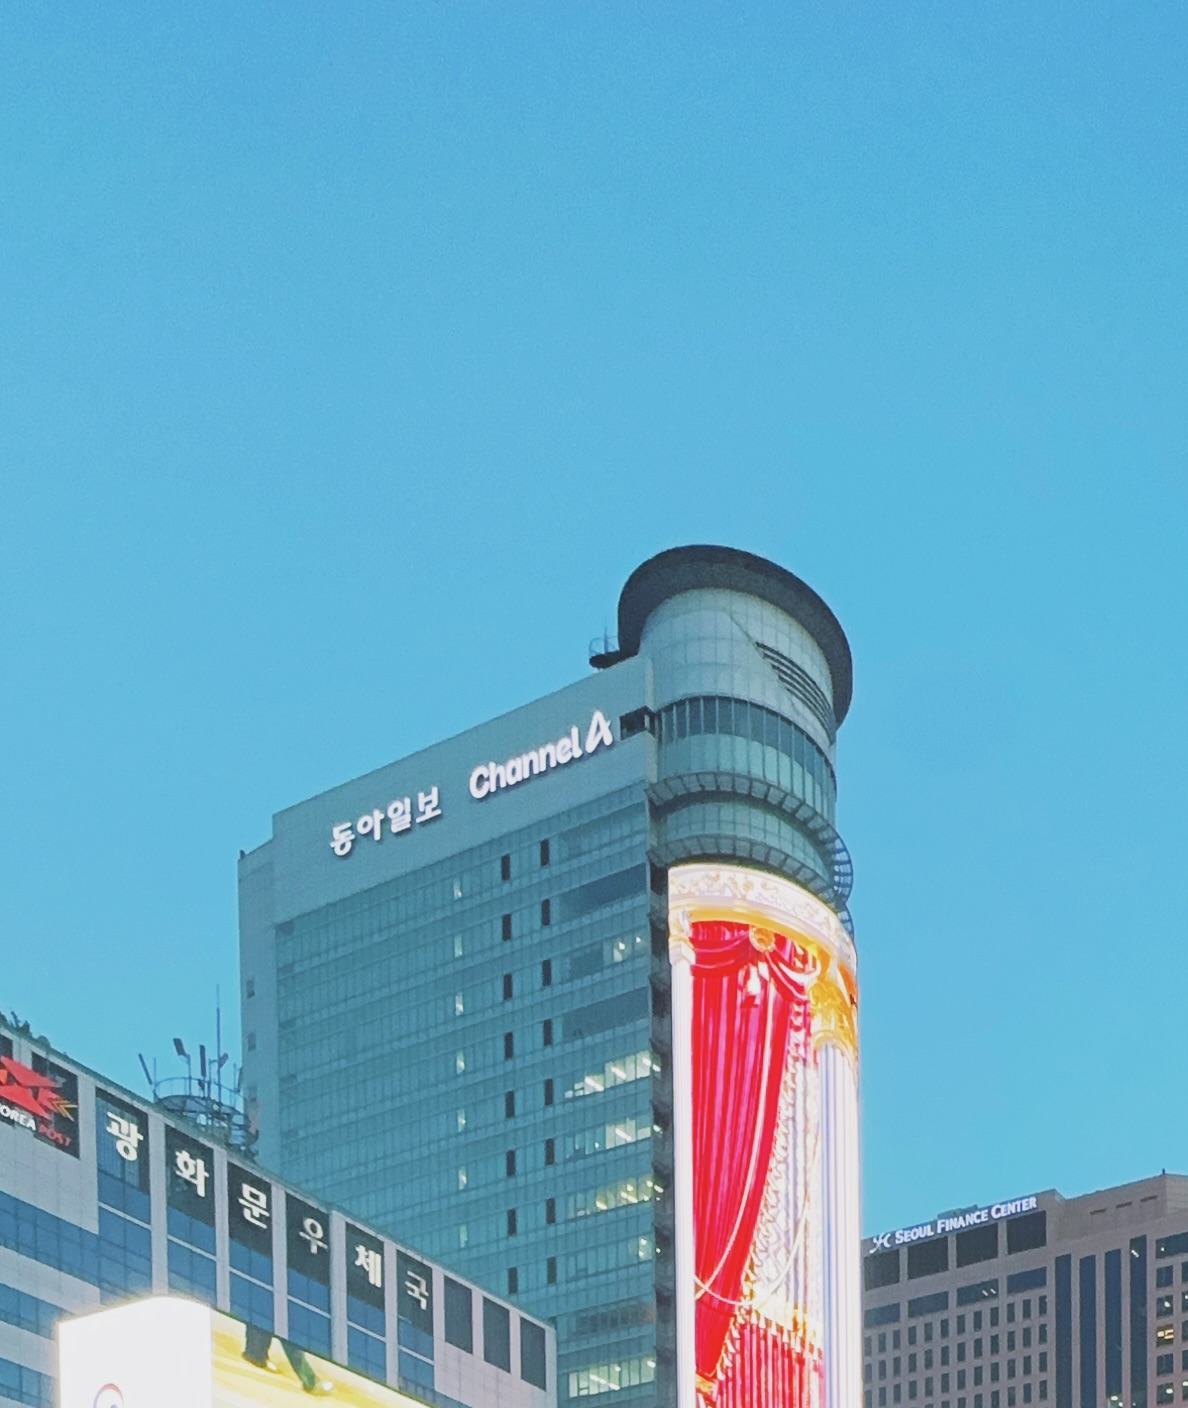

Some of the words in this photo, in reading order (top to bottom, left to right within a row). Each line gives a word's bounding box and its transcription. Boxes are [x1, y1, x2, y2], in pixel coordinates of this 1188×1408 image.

[469, 725, 583, 799] Channel
[329, 786, 442, 856] 동아일보
[0, 1103, 37, 1131] OREA
[38, 1123, 72, 1147] POST
[106, 1111, 429, 1310] 광화문우체국
[894, 1225, 935, 1245] SEOUL
[937, 1209, 989, 1234] FINANCE
[990, 1196, 1038, 1219] CENTER
